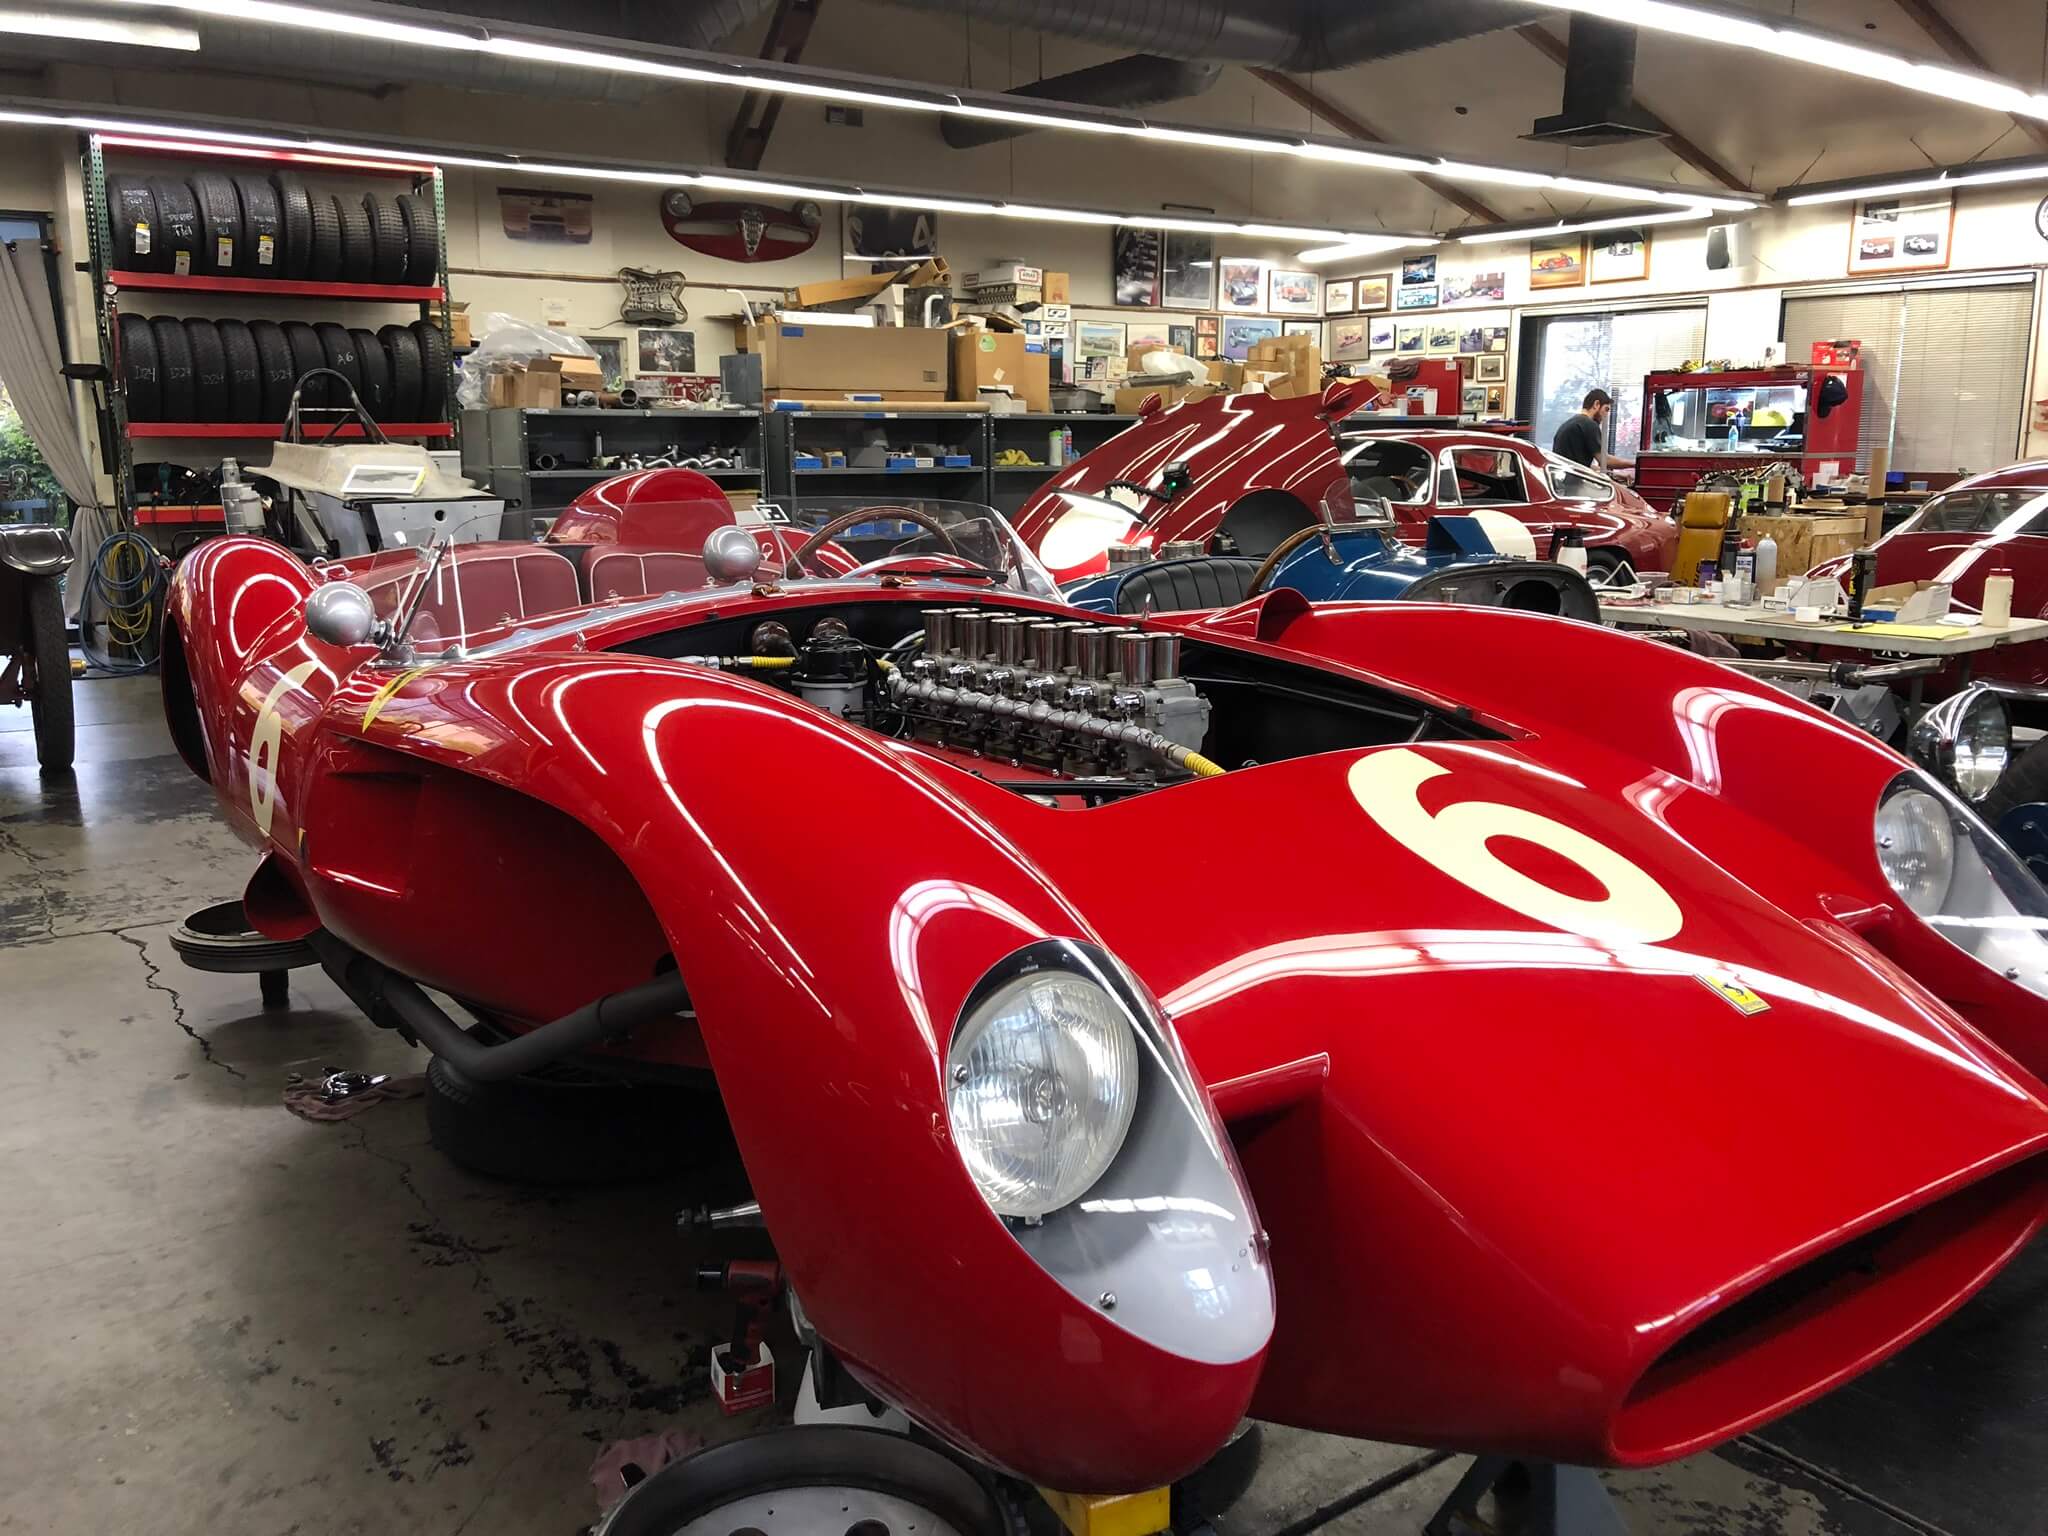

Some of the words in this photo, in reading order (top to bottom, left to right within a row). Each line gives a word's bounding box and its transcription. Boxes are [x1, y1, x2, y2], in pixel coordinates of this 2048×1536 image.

[978, 285, 1015, 295] ARIAS
[249, 660, 320, 836] 6
[1347, 748, 1683, 944] 6
